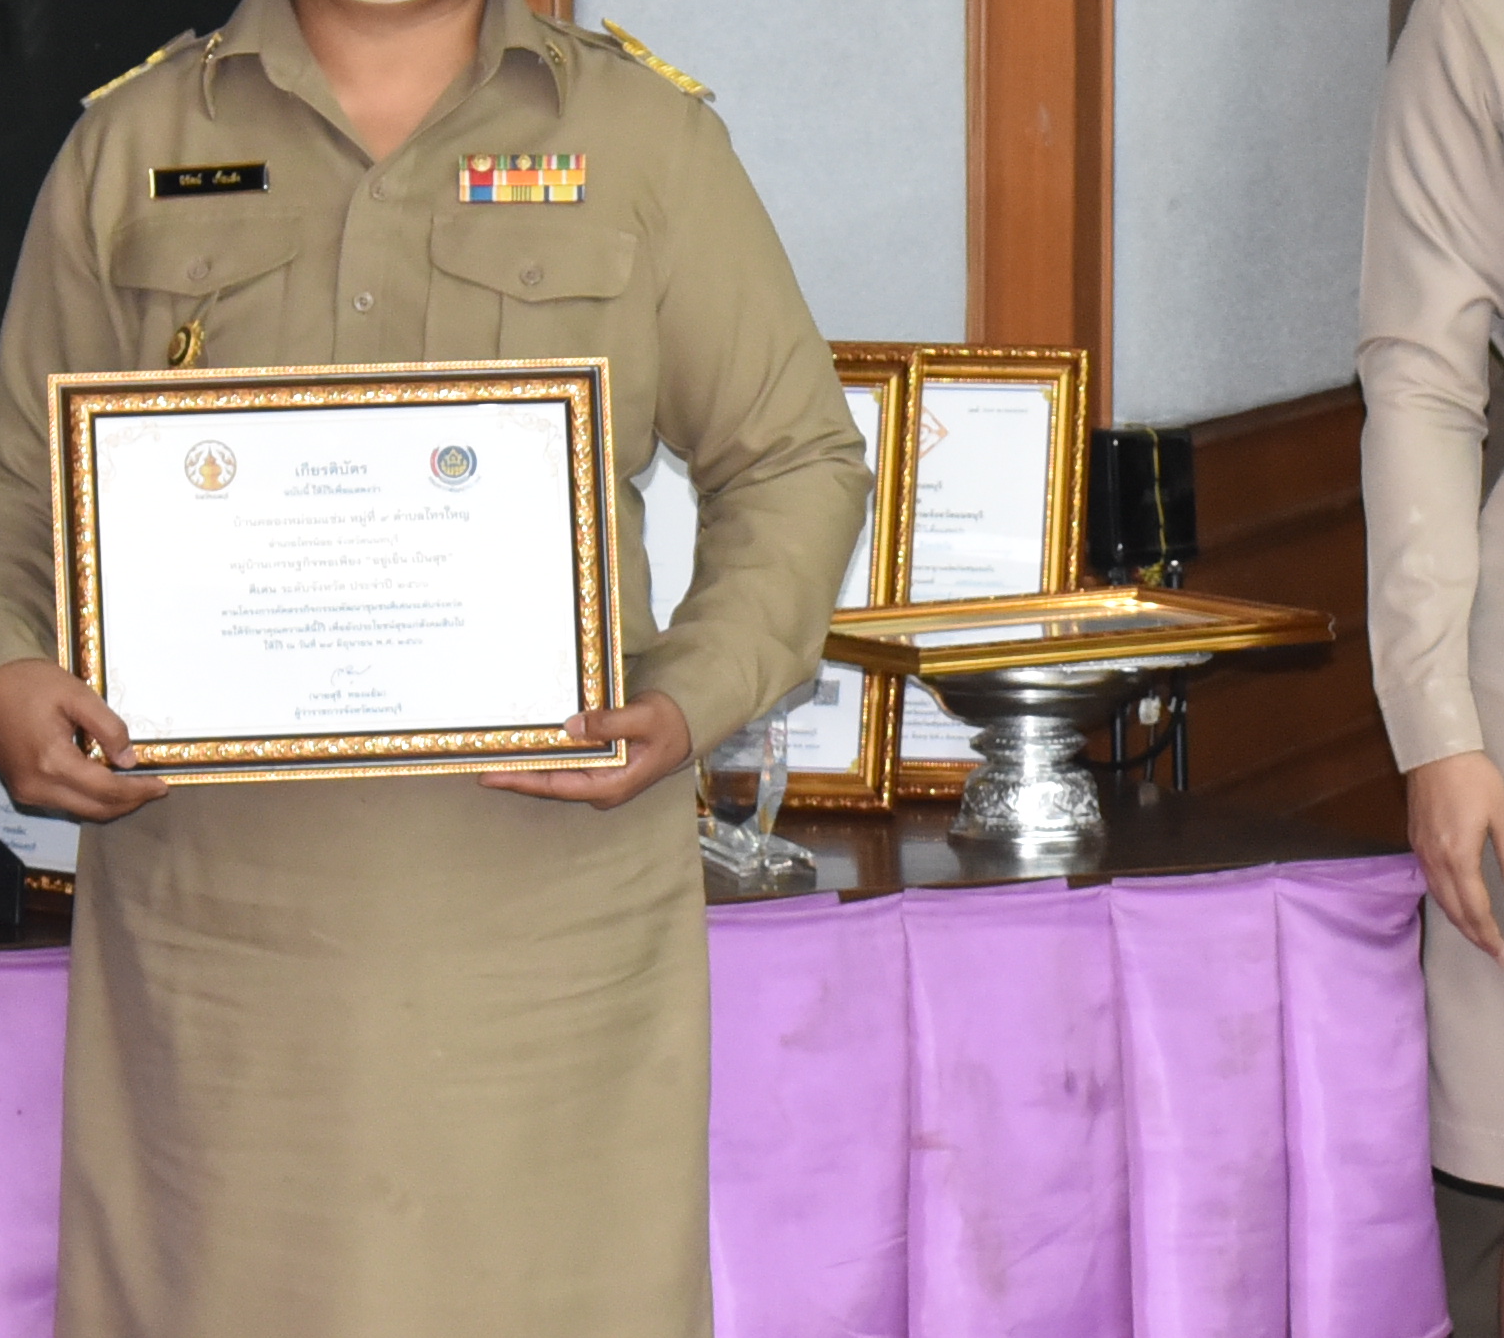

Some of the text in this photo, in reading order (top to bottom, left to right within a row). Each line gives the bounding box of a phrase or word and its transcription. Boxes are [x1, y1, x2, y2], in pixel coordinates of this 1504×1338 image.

[295, 460, 368, 478] เกียรติบัตร
